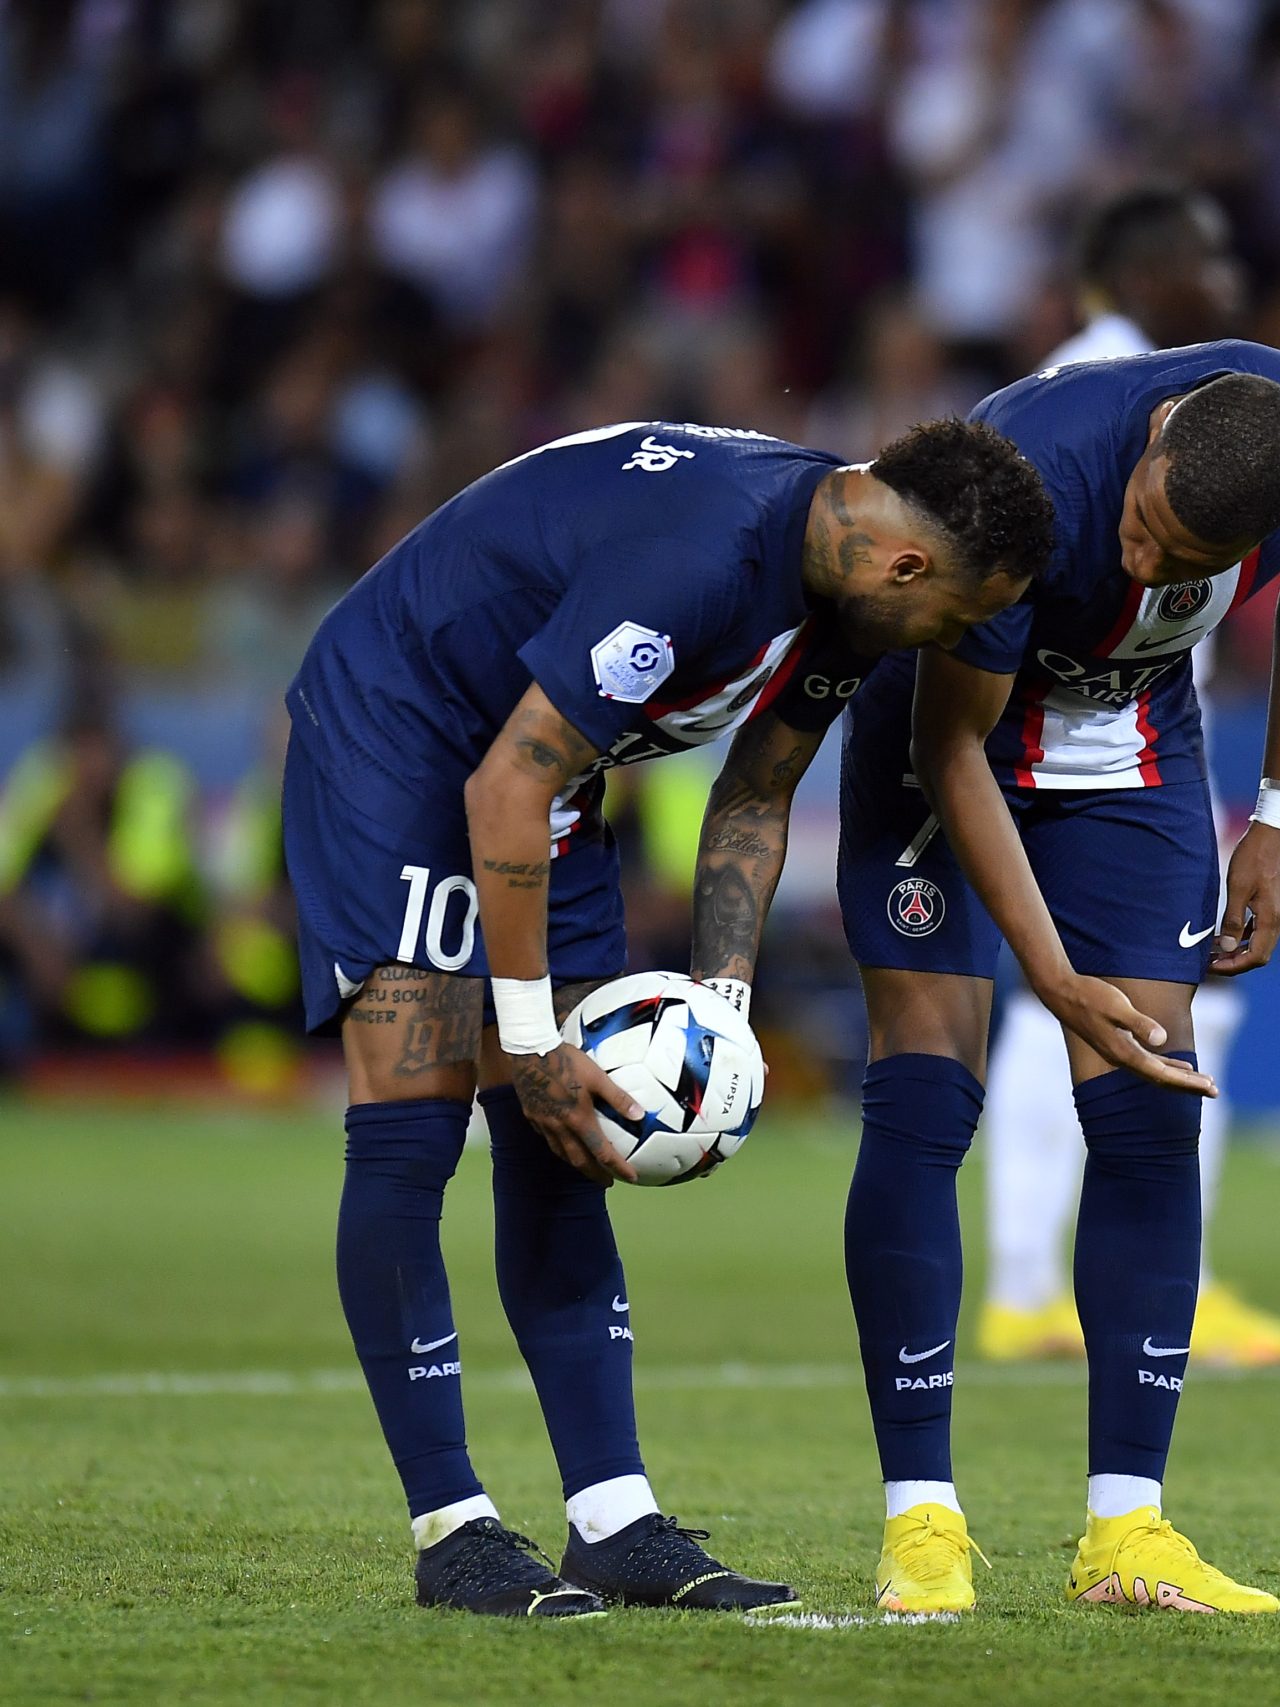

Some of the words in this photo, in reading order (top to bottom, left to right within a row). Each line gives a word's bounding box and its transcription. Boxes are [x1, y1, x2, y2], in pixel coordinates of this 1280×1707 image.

[898, 881, 937, 897] PARIS
[396, 864, 480, 972] 10
[721, 1072, 740, 1116] KIPSTA
[895, 1371, 954, 1391] PARIS
[1138, 1369, 1183, 1393] PAR
[1075, 1571, 1220, 1614] AIR
